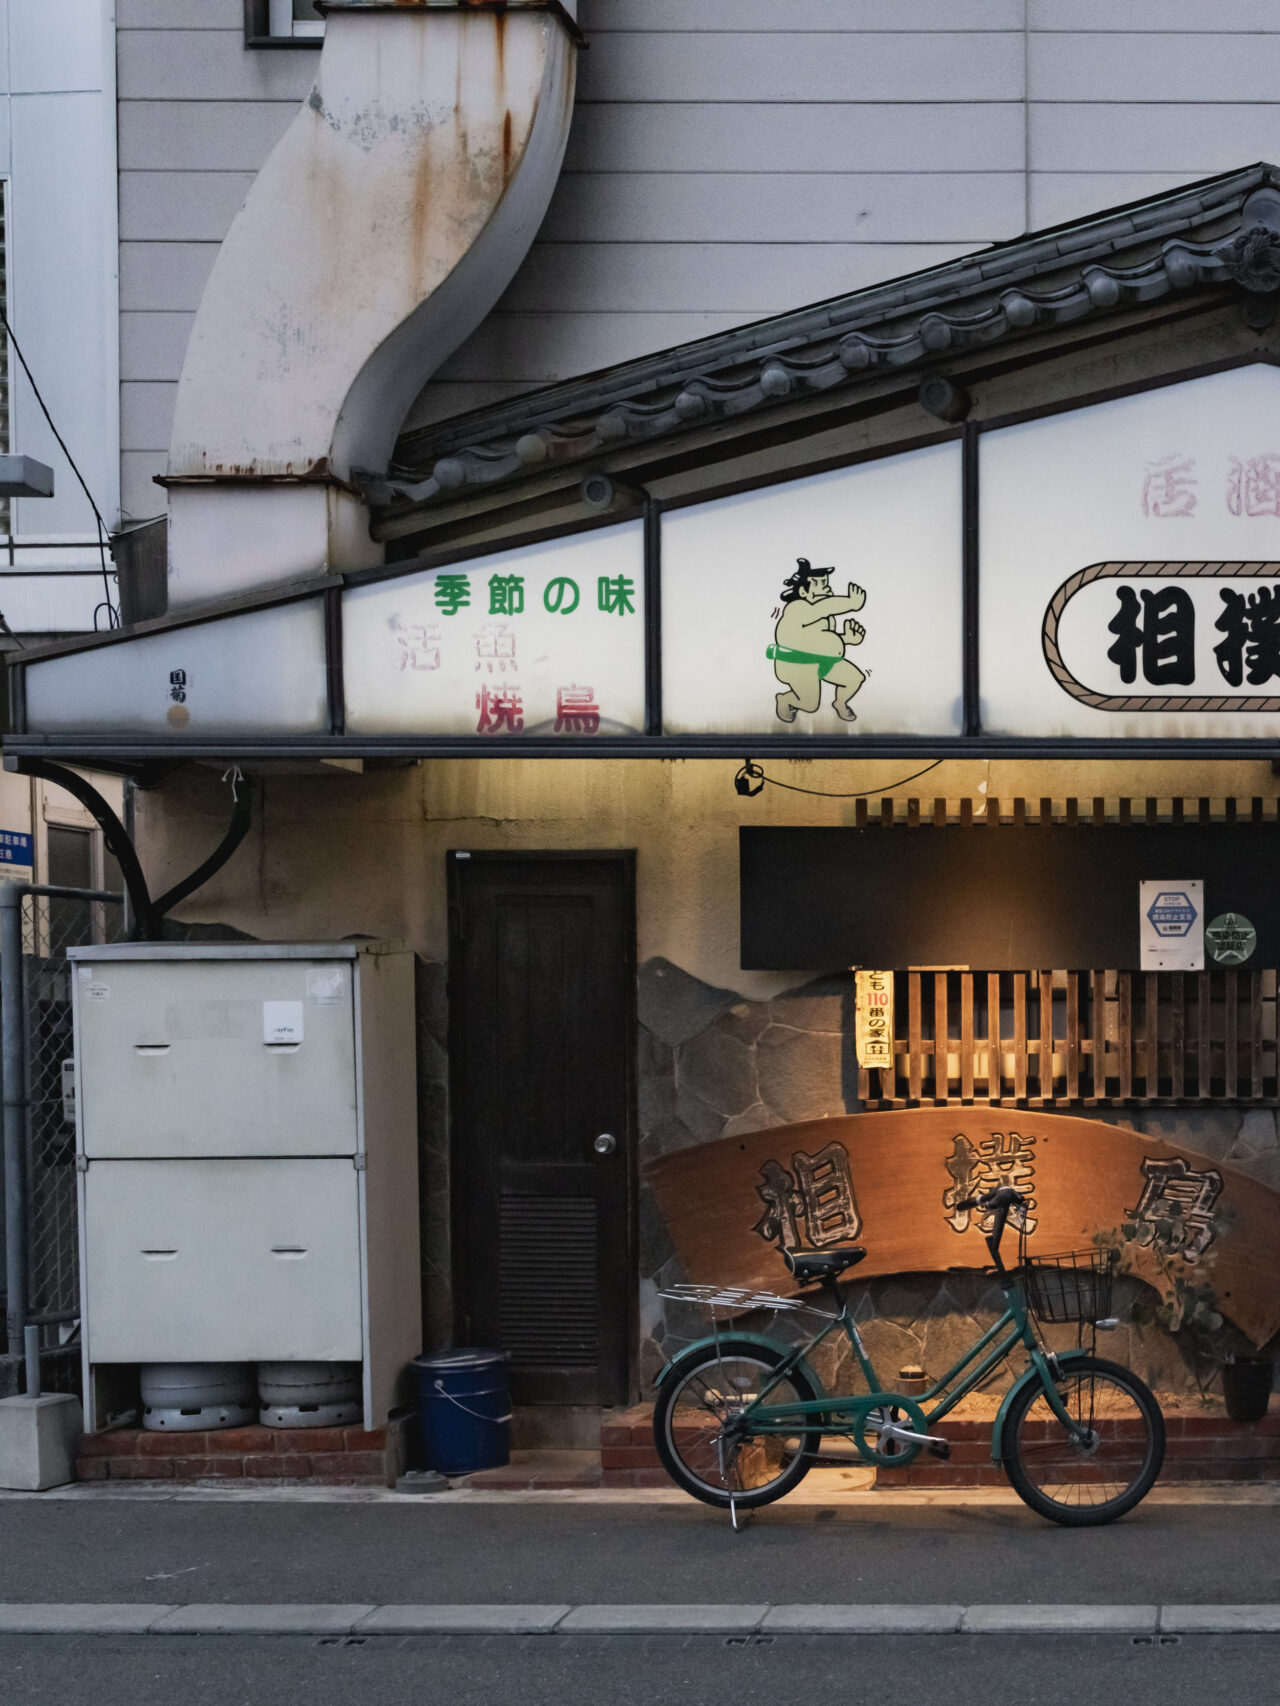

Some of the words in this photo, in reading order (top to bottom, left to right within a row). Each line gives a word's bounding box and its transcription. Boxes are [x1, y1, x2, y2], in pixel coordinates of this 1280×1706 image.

[434, 573, 636, 616] 季節の味
[397, 622, 519, 673] 活魚
[169, 668, 187, 704] 国菊
[475, 681, 601, 735] 焼鳥
[1151, 913, 1193, 921] 感染防止宣言
